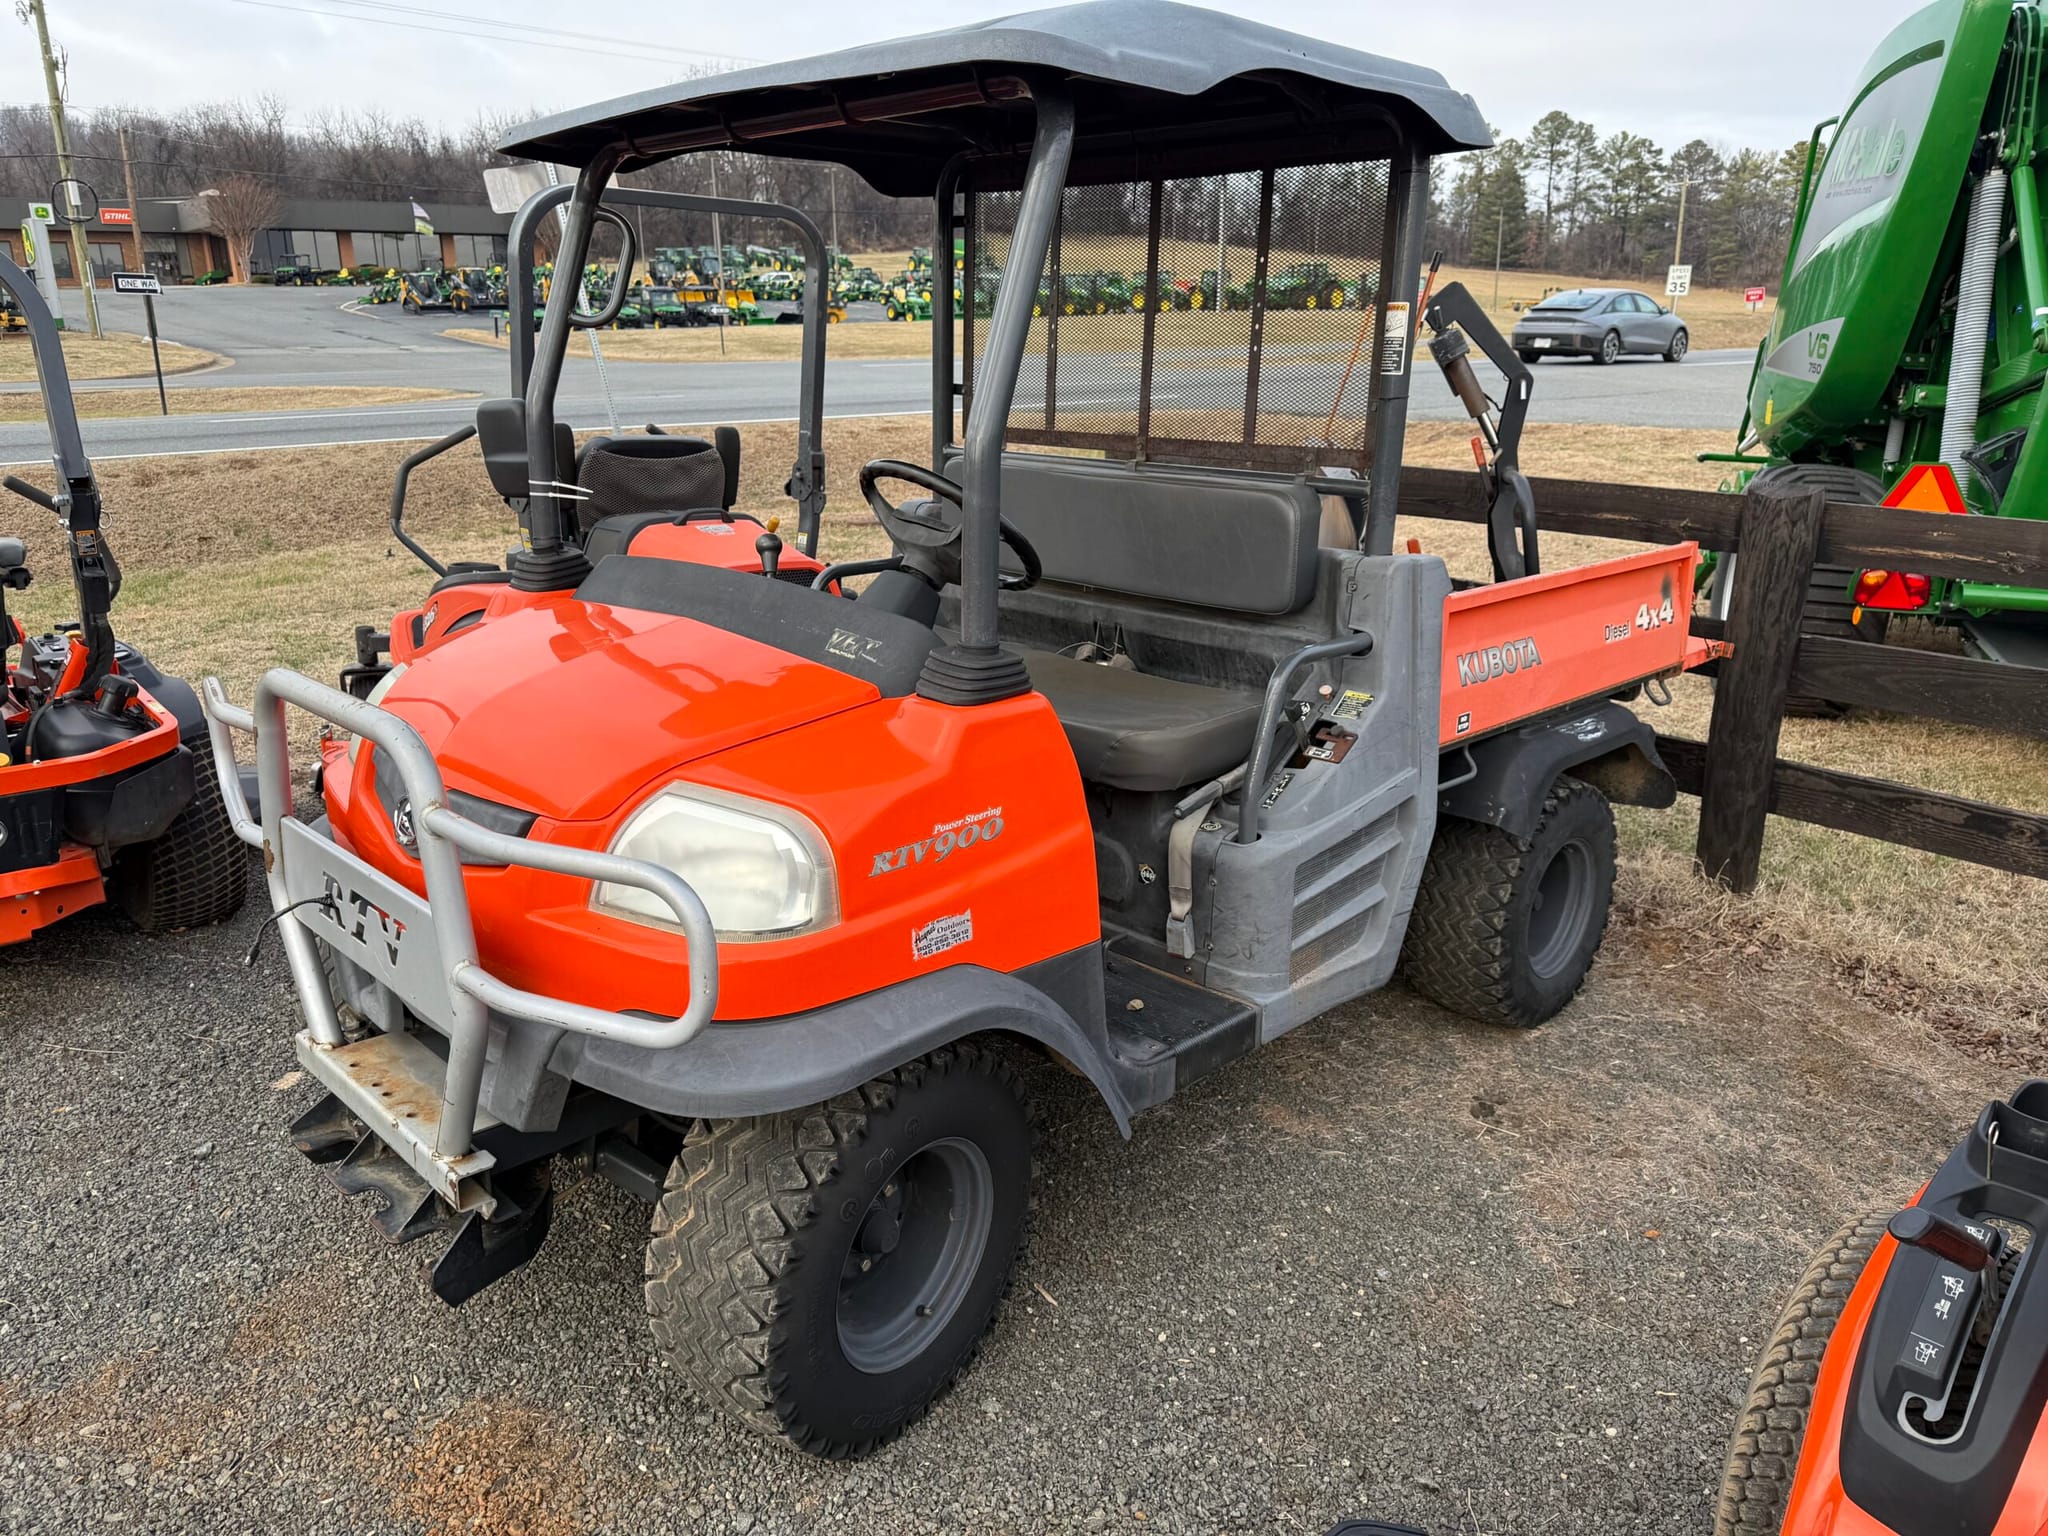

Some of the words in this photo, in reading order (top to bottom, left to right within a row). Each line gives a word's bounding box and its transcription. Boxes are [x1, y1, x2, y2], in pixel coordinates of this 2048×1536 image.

[104, 212, 132, 220] STIHL
[120, 279, 139, 288] ONE
[141, 280, 157, 288] WAY
[1669, 281, 1687, 293] 35
[1808, 331, 1830, 360] V6
[1808, 361, 1823, 375] 750
[1604, 620, 1631, 643] Diesel
[1635, 598, 1674, 631] 4x4
[1456, 636, 1543, 687] KUBOTA
[932, 818, 964, 835] Power
[964, 805, 1003, 825] Steering
[867, 816, 1004, 878] RTV900
[318, 870, 408, 968] RTV
